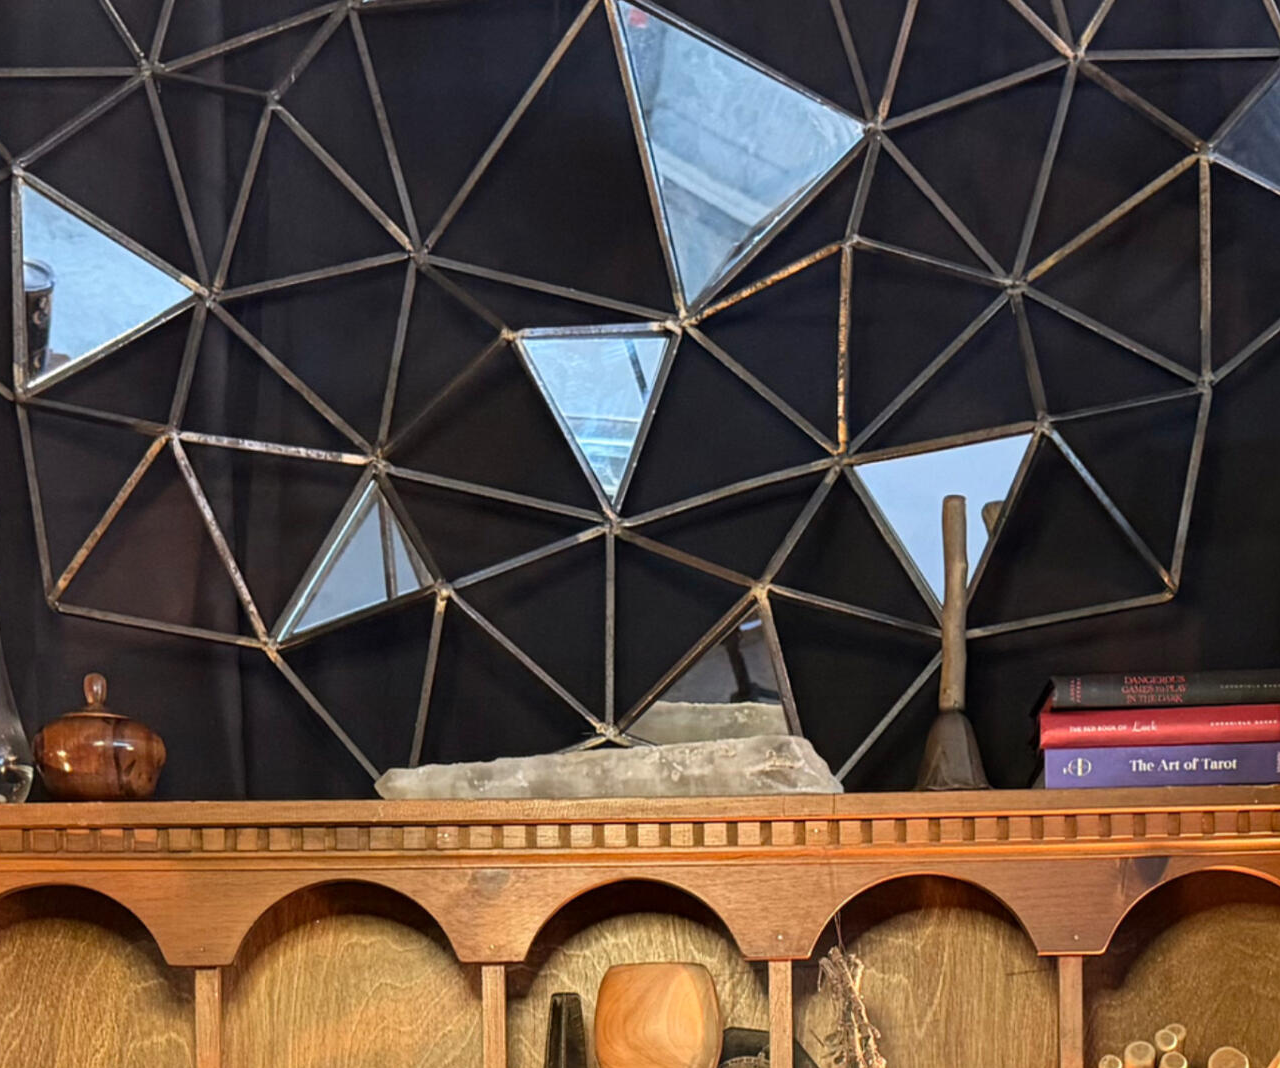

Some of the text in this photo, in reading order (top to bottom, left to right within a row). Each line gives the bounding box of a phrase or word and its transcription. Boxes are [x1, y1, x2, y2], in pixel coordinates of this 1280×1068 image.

[1131, 720, 1158, 732] Luck
[1129, 757, 1237, 772] The Art of Tarot
